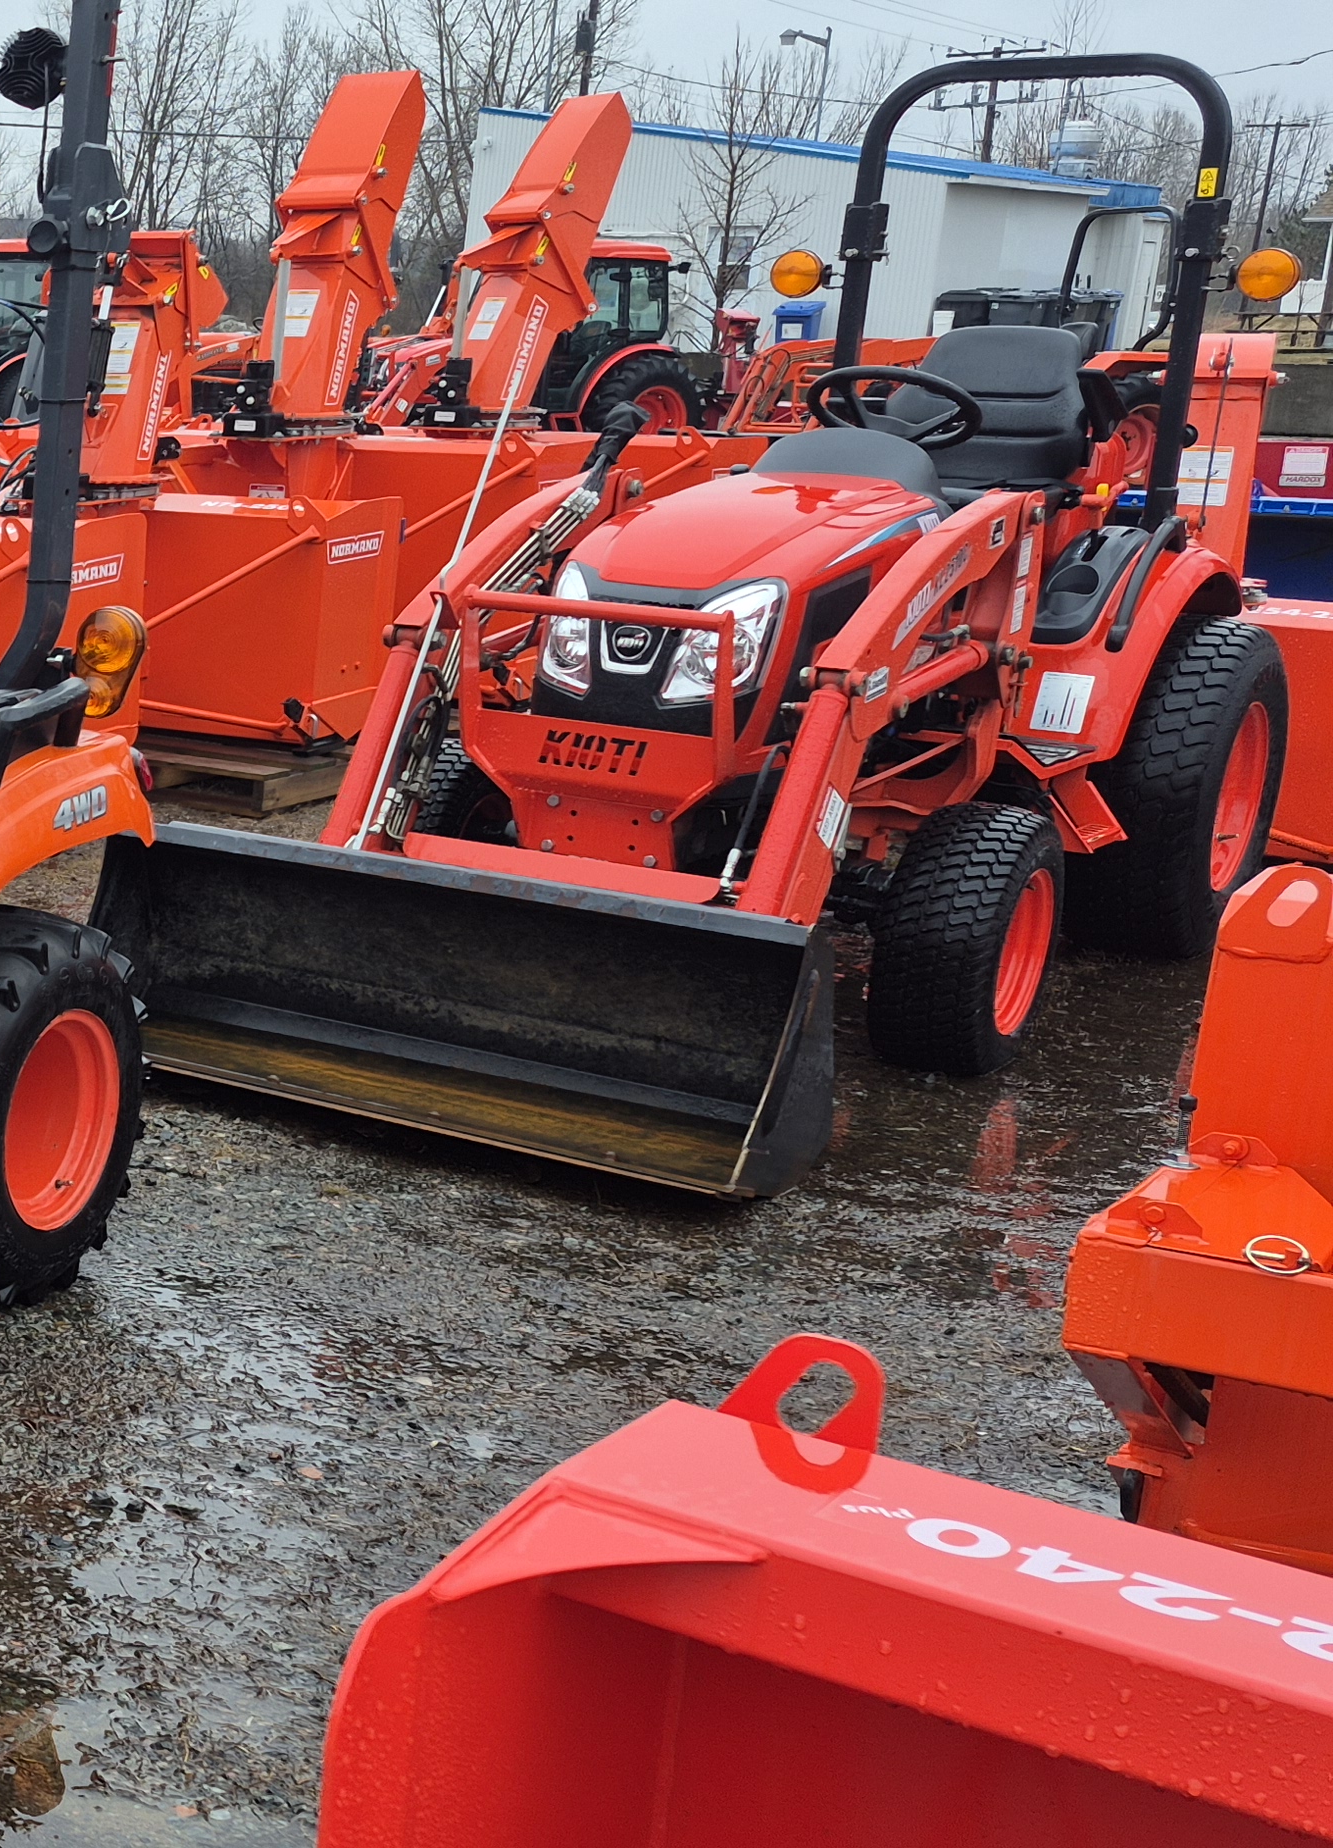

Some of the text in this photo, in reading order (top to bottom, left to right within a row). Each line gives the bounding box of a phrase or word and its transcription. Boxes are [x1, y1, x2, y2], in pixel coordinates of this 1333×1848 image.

[330, 301, 356, 398] NORMAND
[330, 537, 380, 559] NORMAND
[71, 562, 117, 584] RMAND
[538, 729, 649, 777] KIOTI
[53, 784, 108, 832] 4WD
